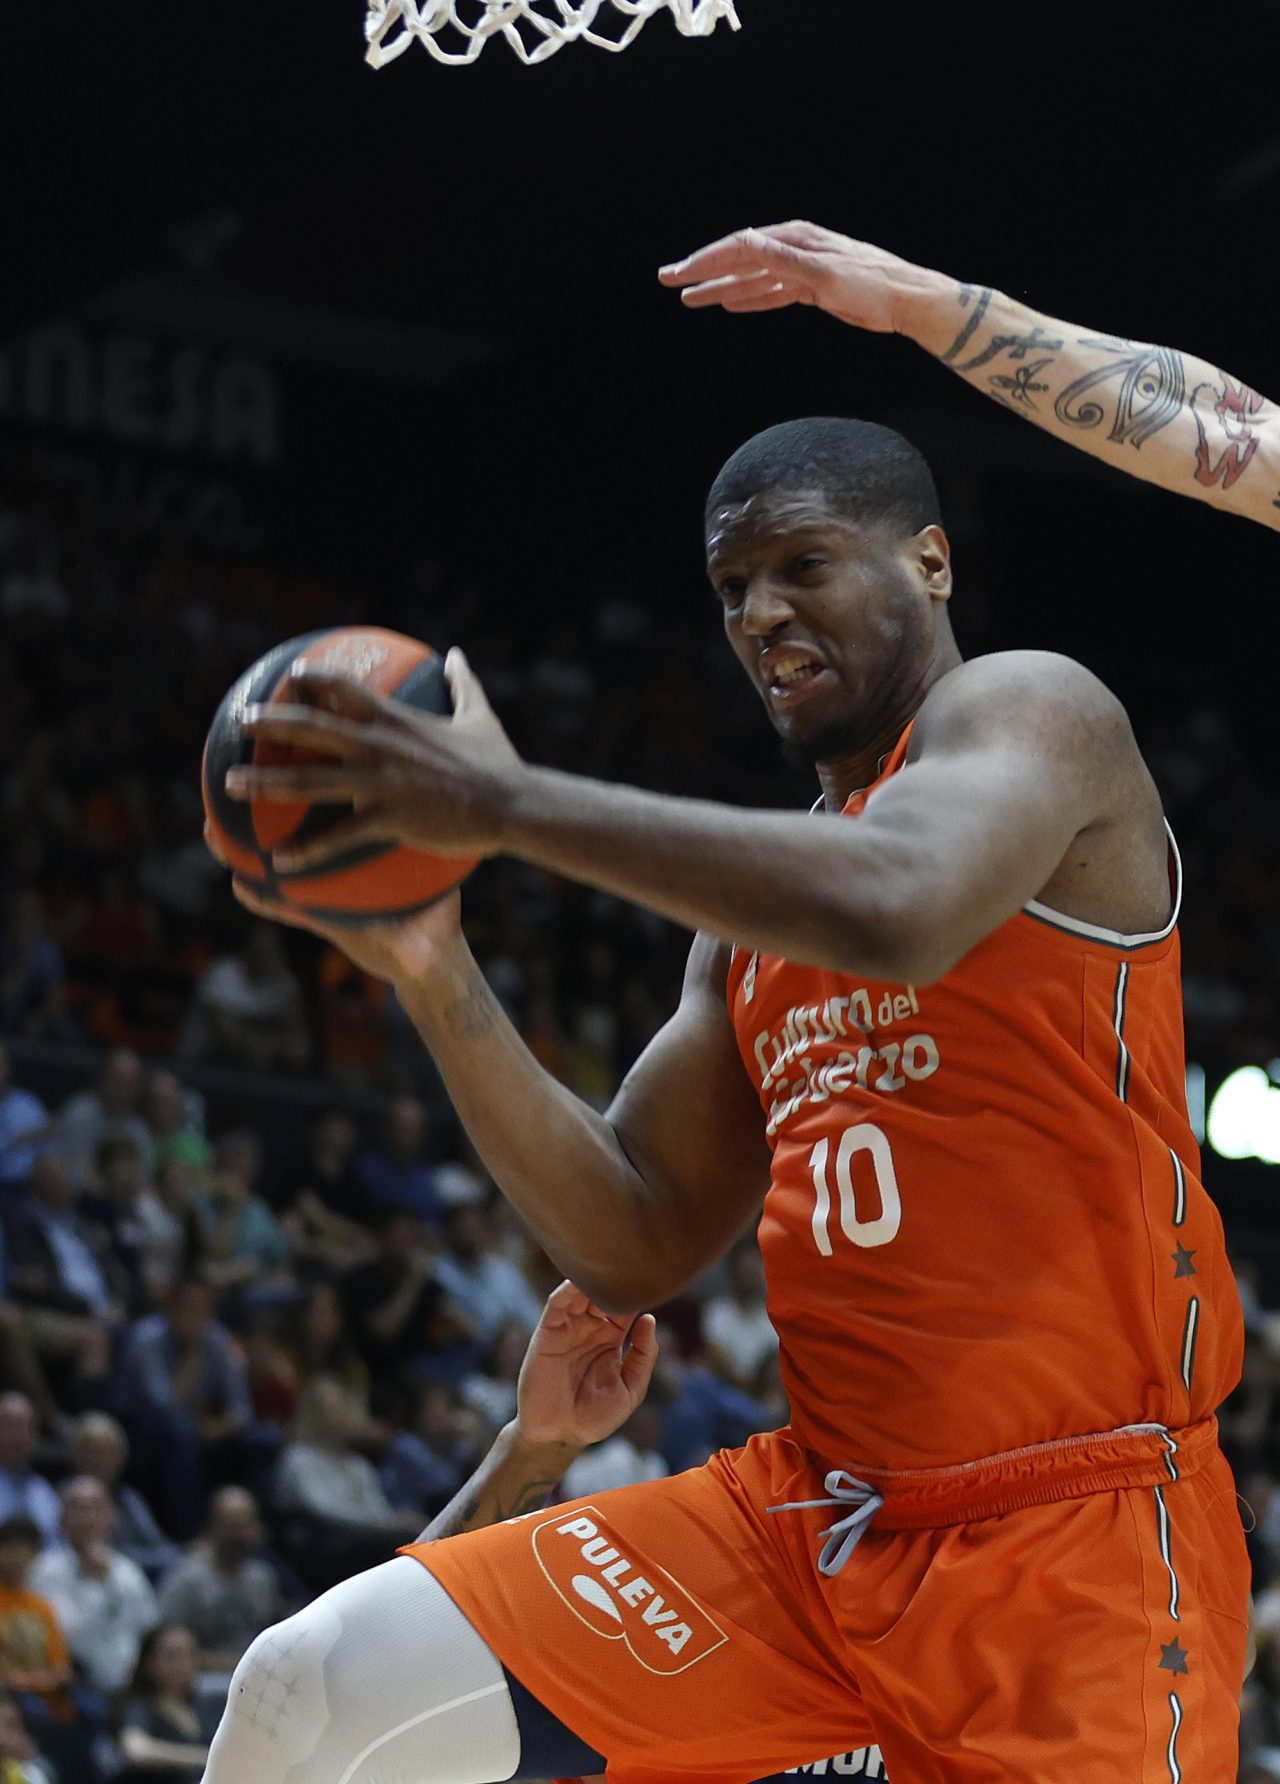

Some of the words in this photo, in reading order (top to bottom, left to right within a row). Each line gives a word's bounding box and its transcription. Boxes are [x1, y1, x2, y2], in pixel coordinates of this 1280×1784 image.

[0, 319, 284, 468] NESA
[878, 984, 919, 1027] del
[808, 1123, 902, 1257] 10
[556, 1517, 693, 1656] PULEVA
